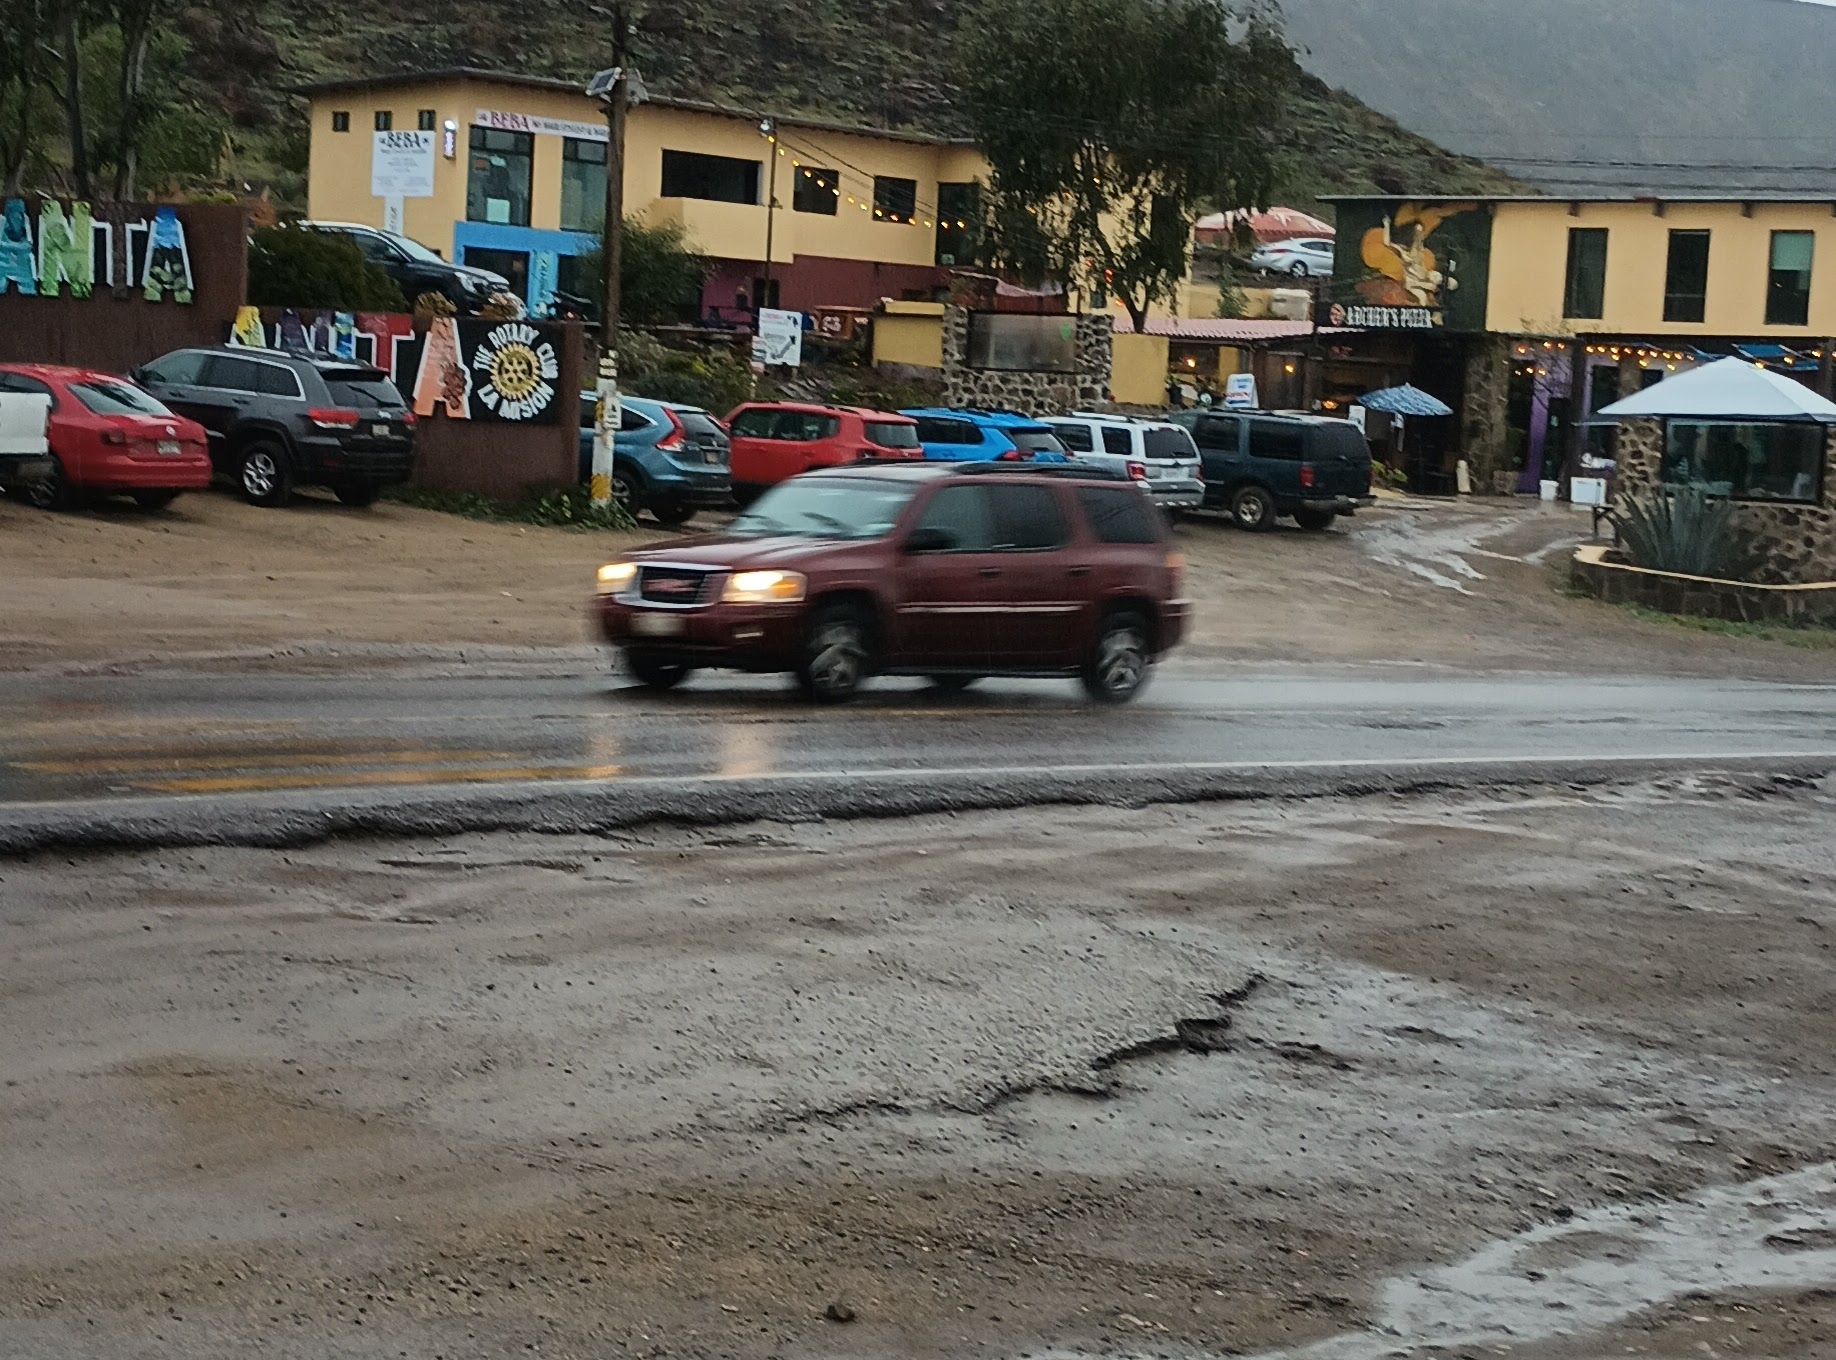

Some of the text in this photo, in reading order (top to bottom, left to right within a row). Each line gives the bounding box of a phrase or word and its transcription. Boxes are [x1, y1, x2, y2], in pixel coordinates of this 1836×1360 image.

[473, 323, 559, 379] THE ROTARY CLUB
[477, 384, 500, 411] LA
